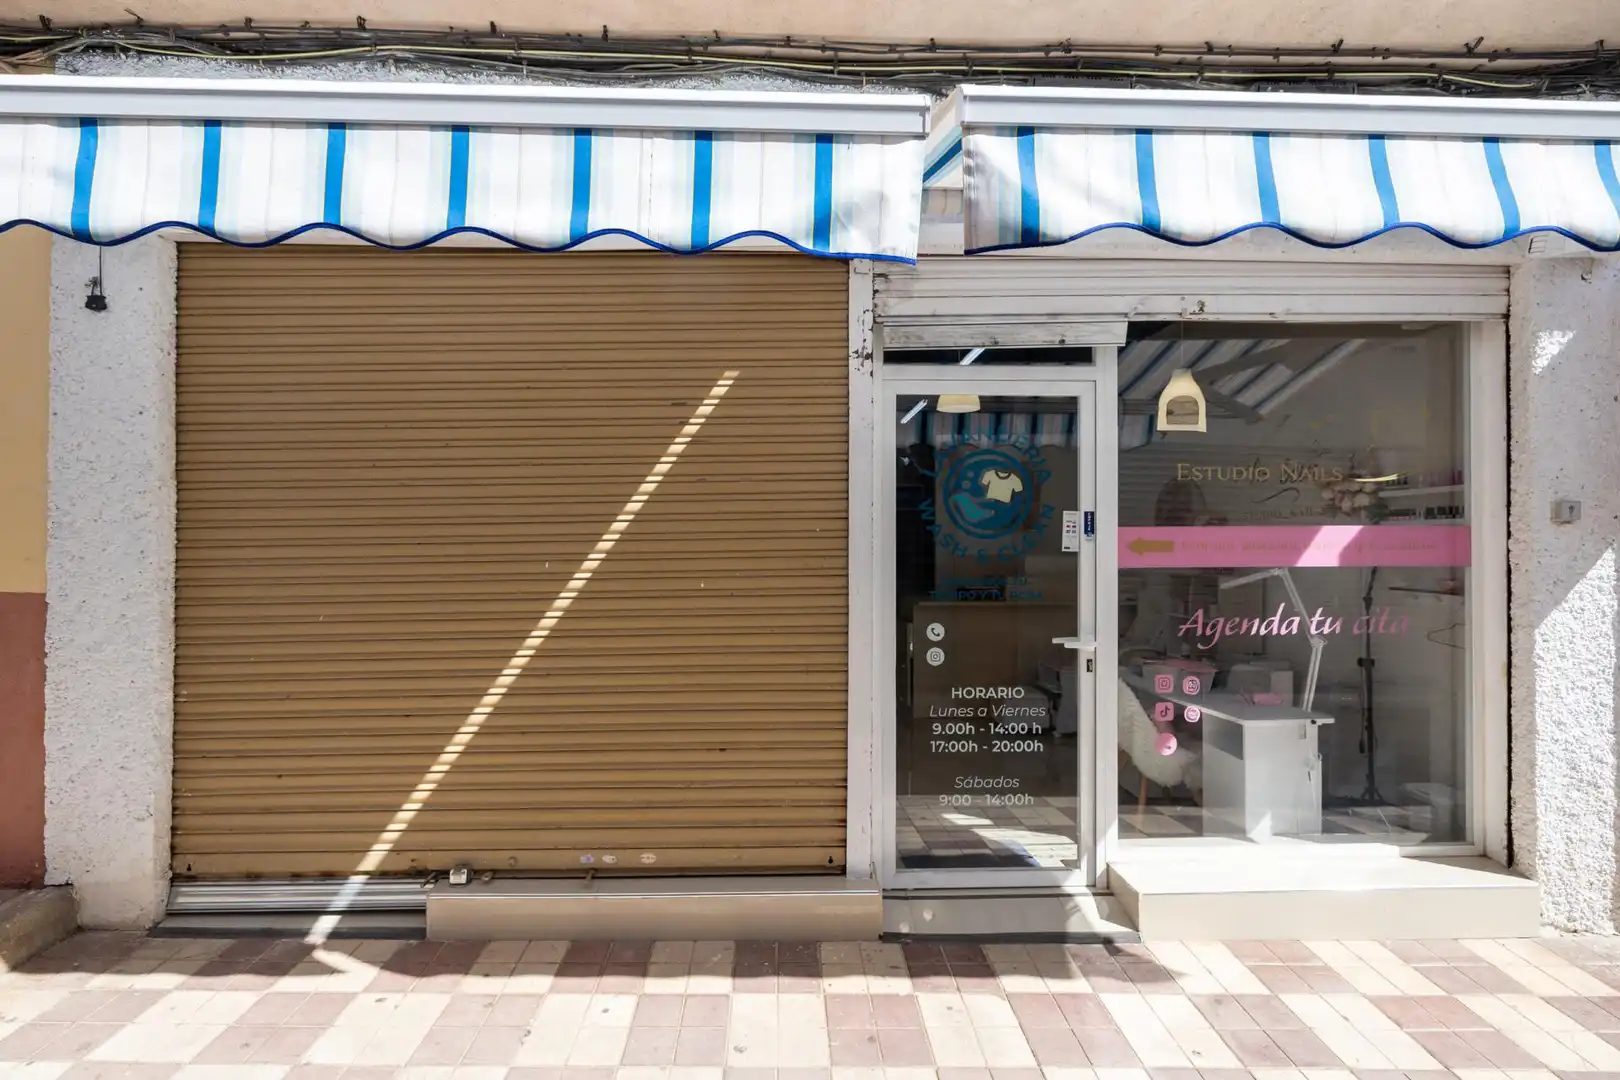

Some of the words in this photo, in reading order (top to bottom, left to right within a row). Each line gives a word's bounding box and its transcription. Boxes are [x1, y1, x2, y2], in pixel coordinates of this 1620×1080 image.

[1177, 463, 1270, 481] ESTUDIO
[1281, 463, 1343, 481] NAILS
[918, 498, 967, 559] WASH
[1177, 602, 1300, 650] Agenda
[1310, 607, 1341, 636] tu
[951, 687, 1025, 699] HORARIO
[929, 705, 974, 717] Lunes
[977, 707, 988, 717] a
[991, 704, 1046, 717] Viernes
[932, 722, 975, 735] 9.00h
[989, 722, 1028, 735] 14:00
[1032, 722, 1042, 735] h
[930, 740, 978, 753] 17:00h
[992, 740, 1044, 752] 20:00h
[954, 776, 1020, 788] Sábados
[939, 794, 972, 806] 9:00
[986, 793, 1034, 806] 14:00h
